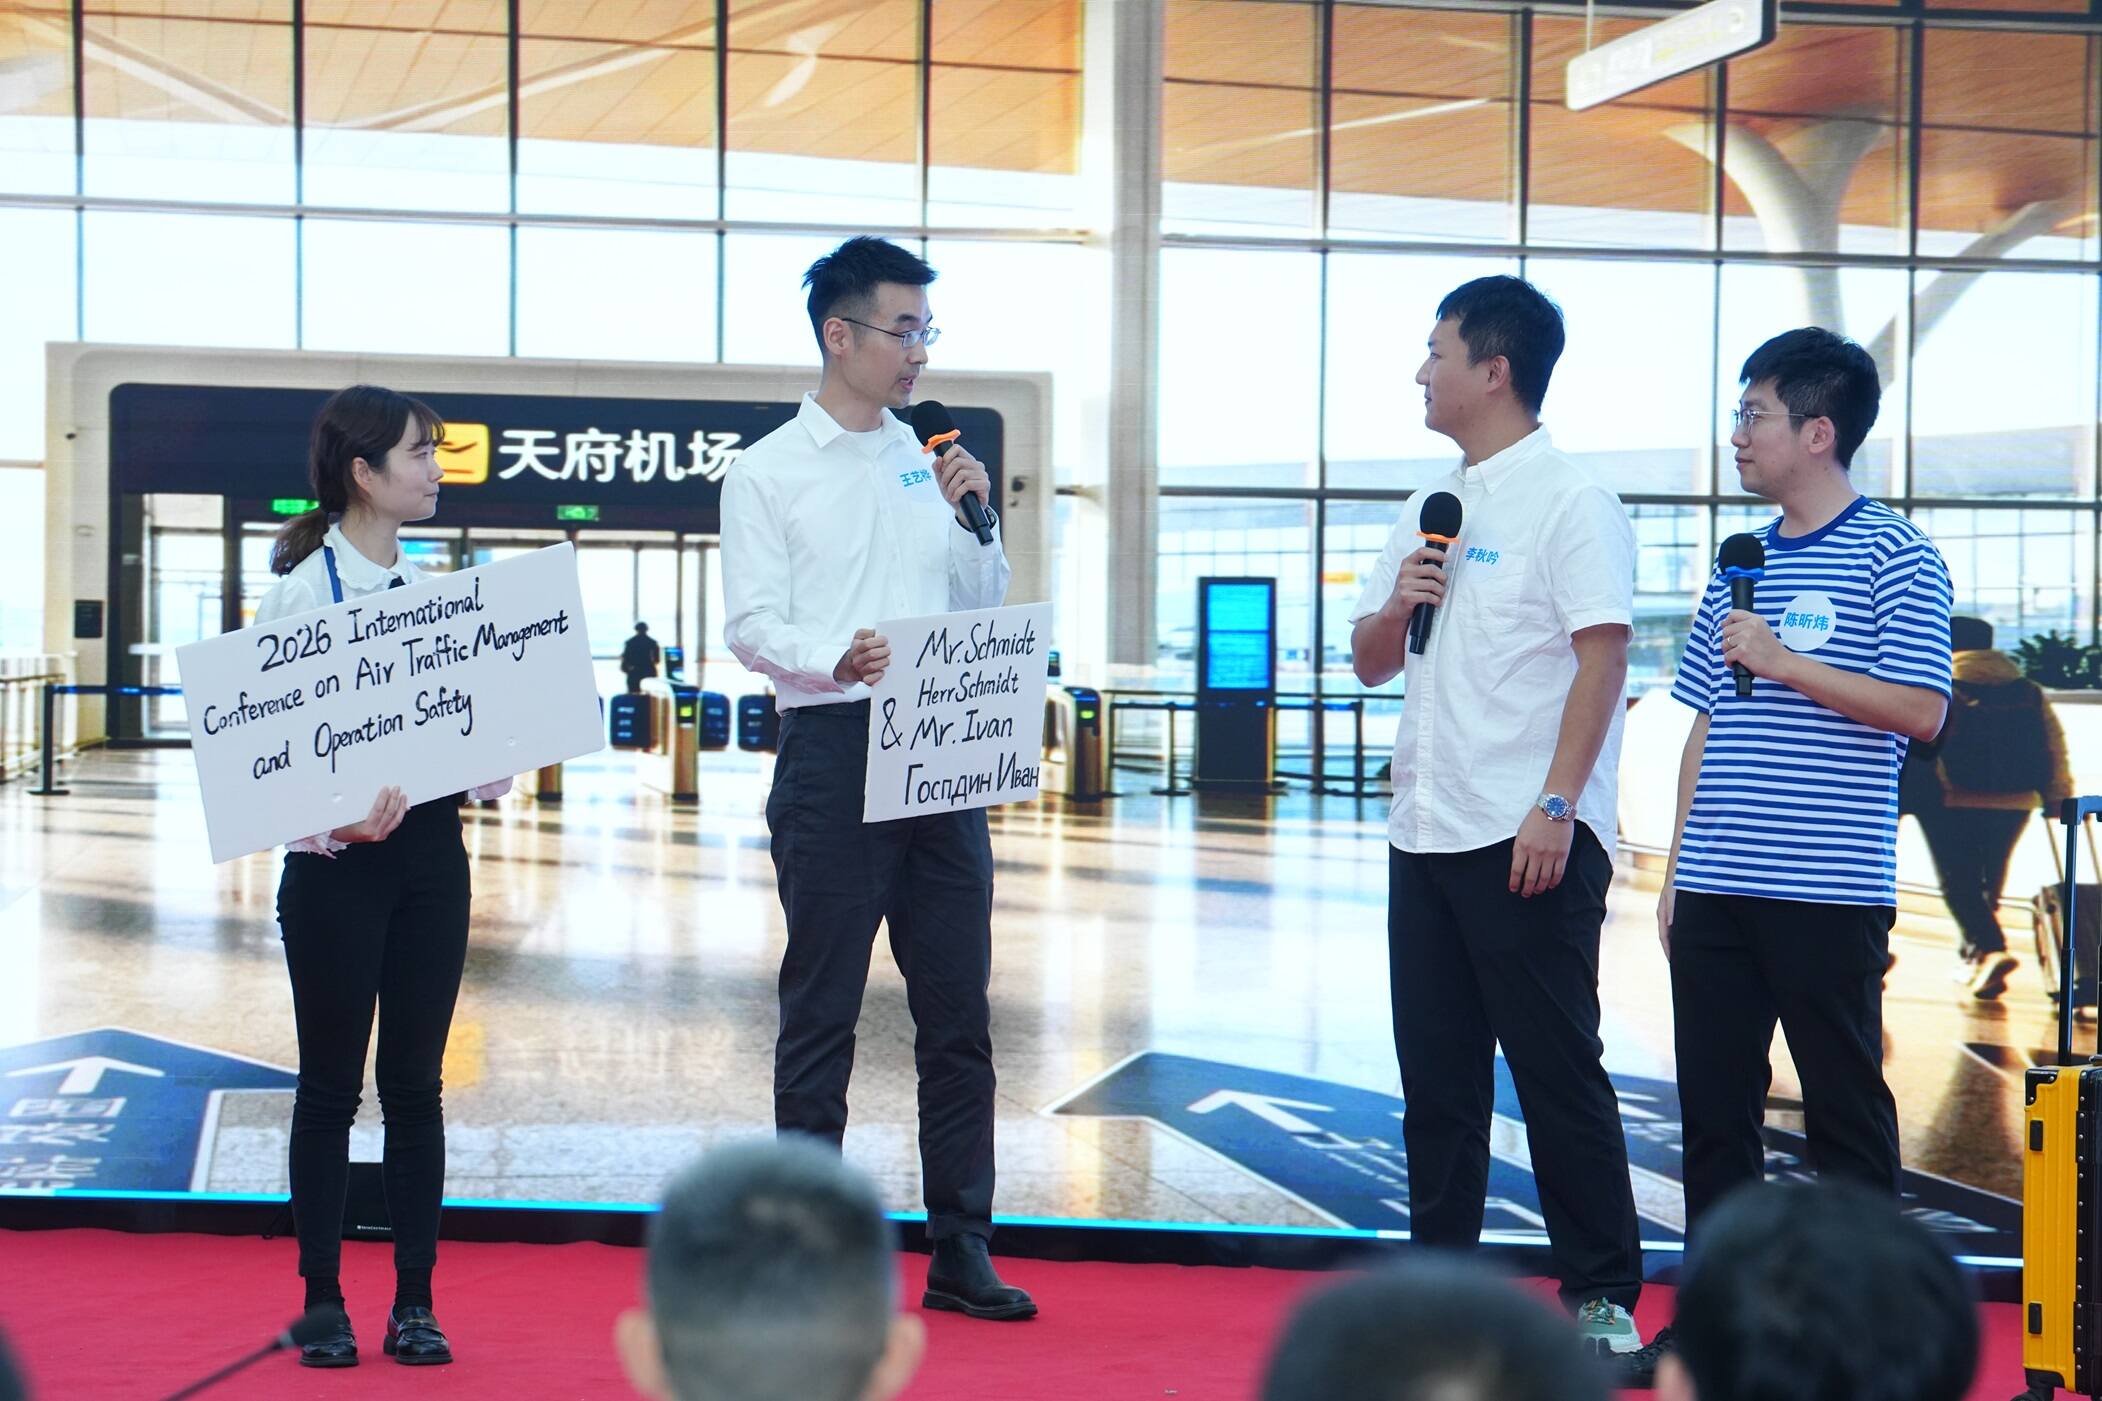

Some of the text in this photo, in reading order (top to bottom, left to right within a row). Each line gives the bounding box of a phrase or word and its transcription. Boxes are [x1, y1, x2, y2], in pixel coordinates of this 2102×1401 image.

[498, 427, 746, 482] 天府机场
[257, 577, 484, 672] 2026 International
[1784, 612, 1830, 631] 陈昕炜
[204, 610, 569, 735] Conference on Air Traffic Management
[253, 686, 473, 779] and Operation Safety
[881, 698, 1012, 750] & Mr. Ivan
[996, 752, 1040, 791] Иван
